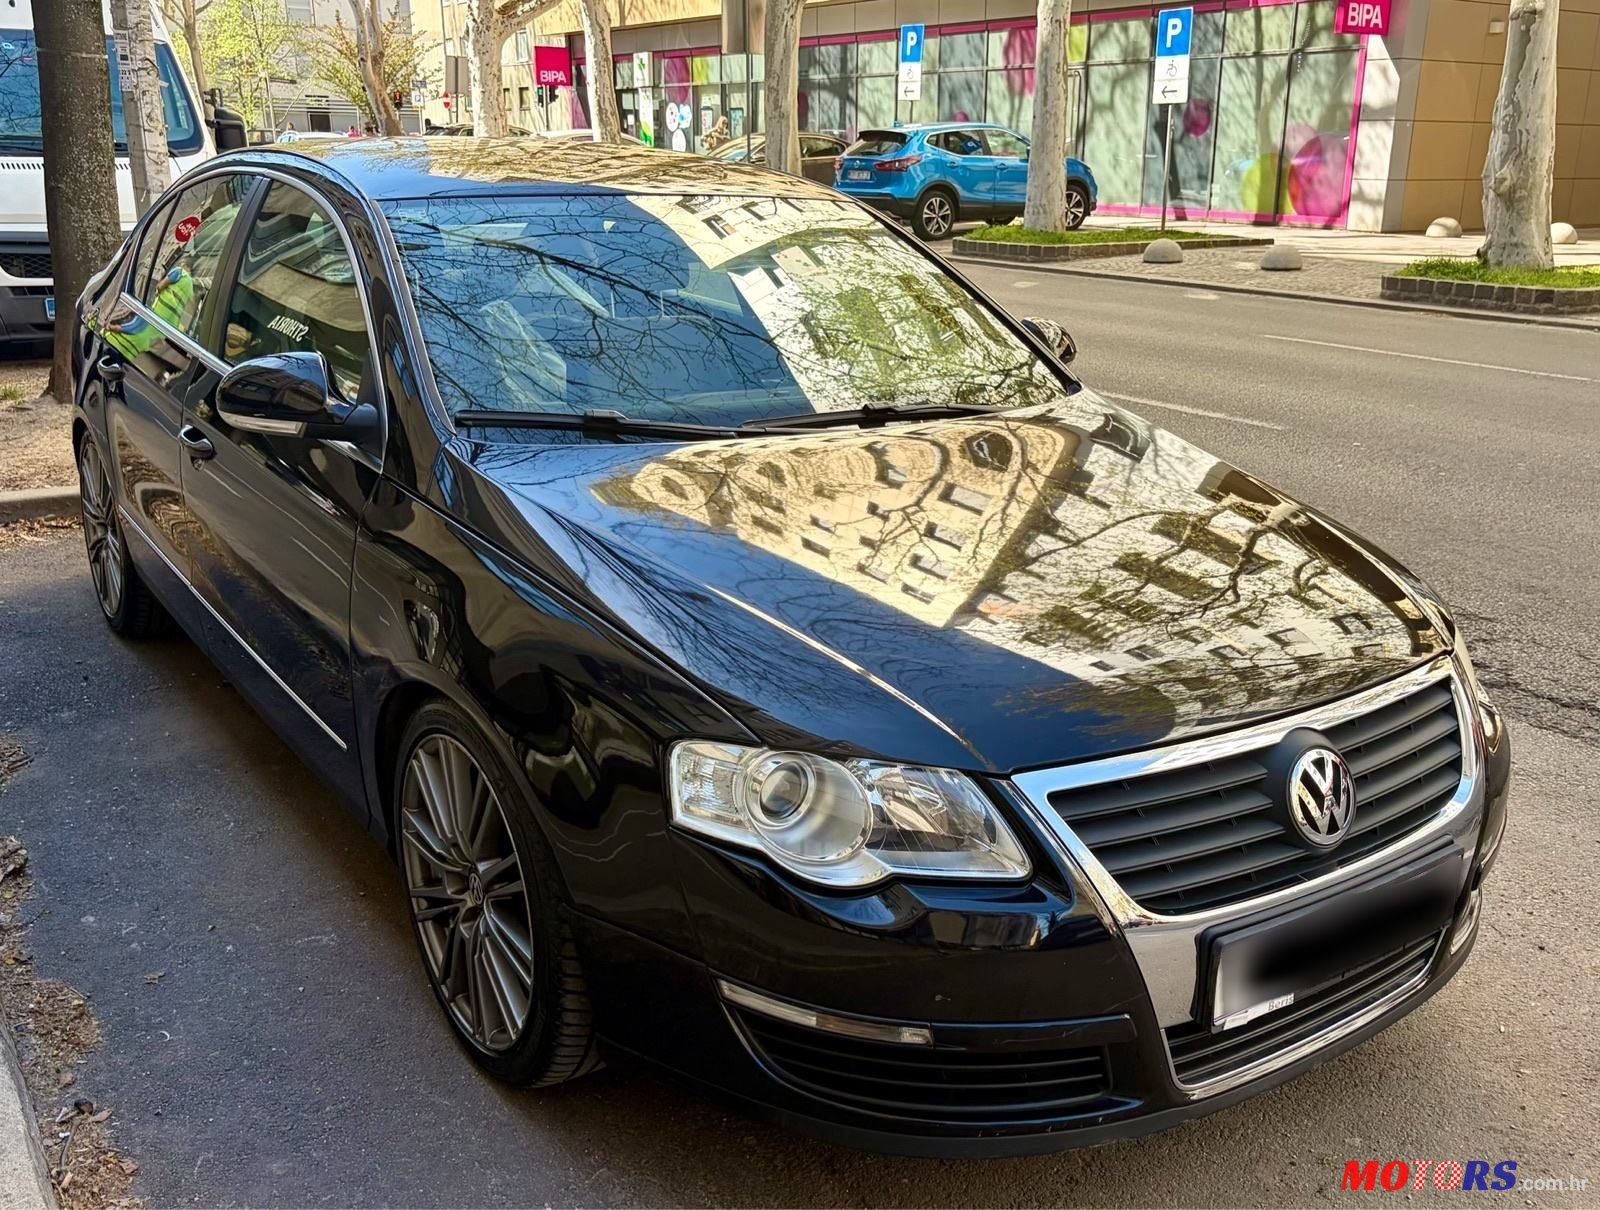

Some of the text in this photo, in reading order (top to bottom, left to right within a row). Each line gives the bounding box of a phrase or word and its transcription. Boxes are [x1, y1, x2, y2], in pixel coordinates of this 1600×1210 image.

[1347, 2, 1383, 29] BIPA
[906, 31, 917, 56] P
[1166, 17, 1182, 48] P
[540, 70, 567, 83] BIPA
[1291, 749, 1352, 844] VW
